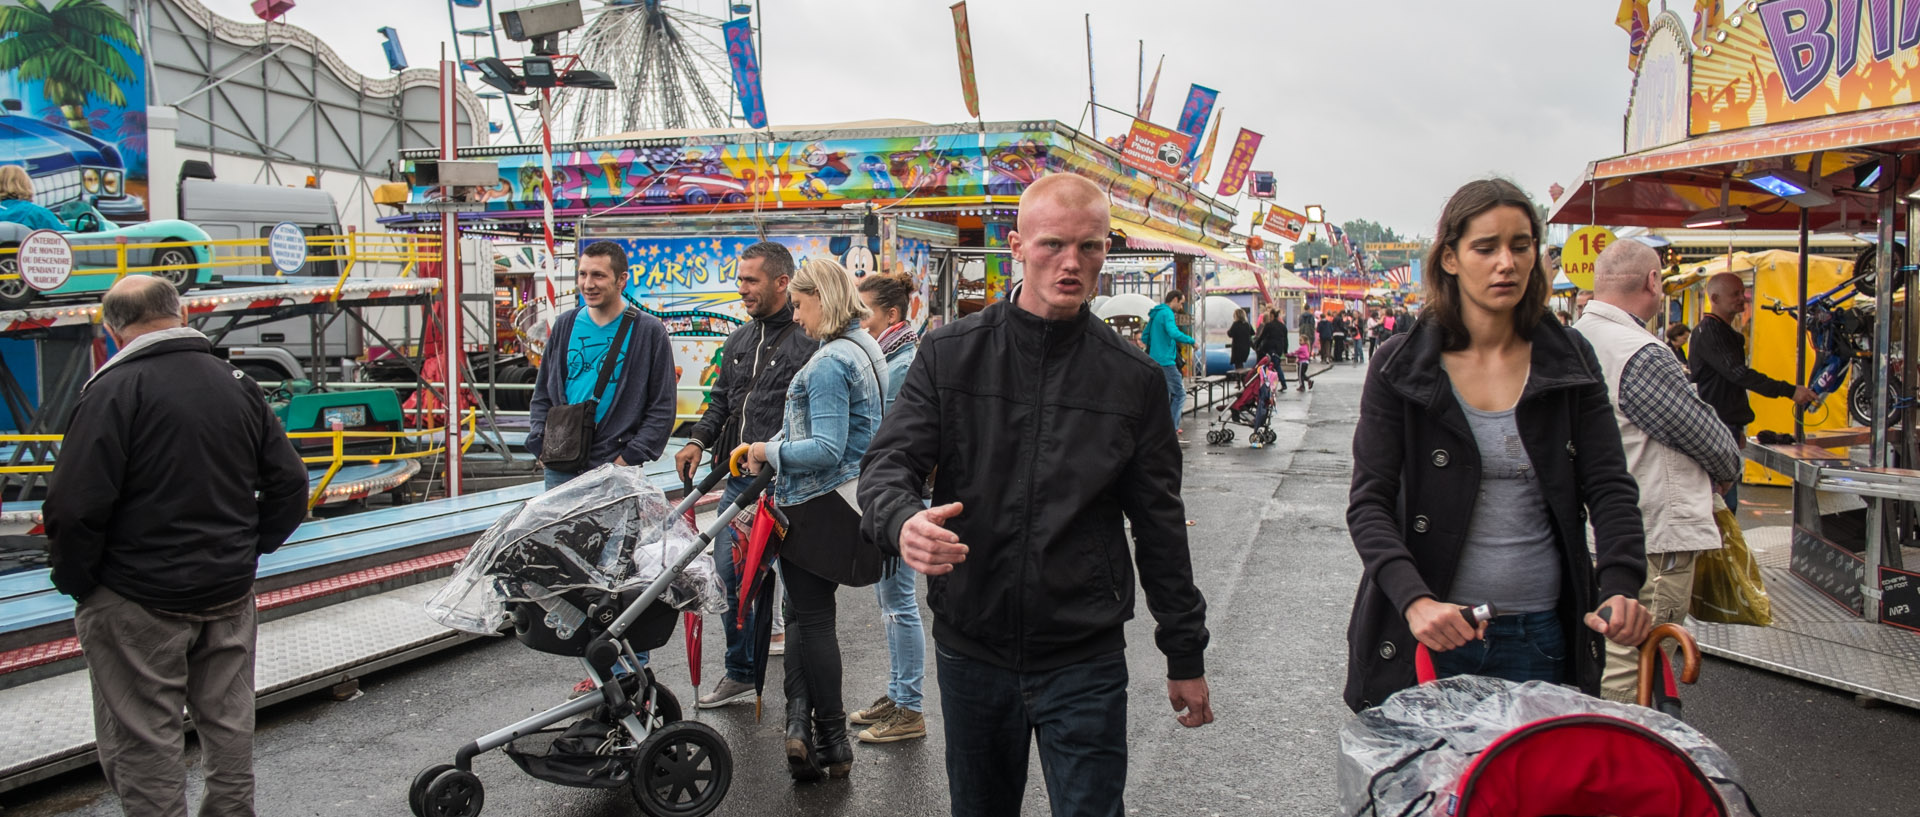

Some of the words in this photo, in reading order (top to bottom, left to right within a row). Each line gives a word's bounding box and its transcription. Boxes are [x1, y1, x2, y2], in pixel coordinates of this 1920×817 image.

[1135, 134, 1156, 148] Votre
[1131, 141, 1155, 155] Photo
[1123, 148, 1157, 164] souvenir
[33, 237, 61, 245] INTERDIT
[1579, 233, 1606, 256] 1€
[39, 247, 65, 255] MONTER
[34, 256, 71, 265] DESCENDRE
[28, 266, 55, 274] PENDANT
[629, 256, 709, 289] PARIS
[1565, 263, 1579, 274] LA
[34, 276, 58, 284] MARCHE
[1817, 371, 1832, 387] 02
[672, 546, 701, 574] Quinny
[1889, 604, 1910, 617] MP3
